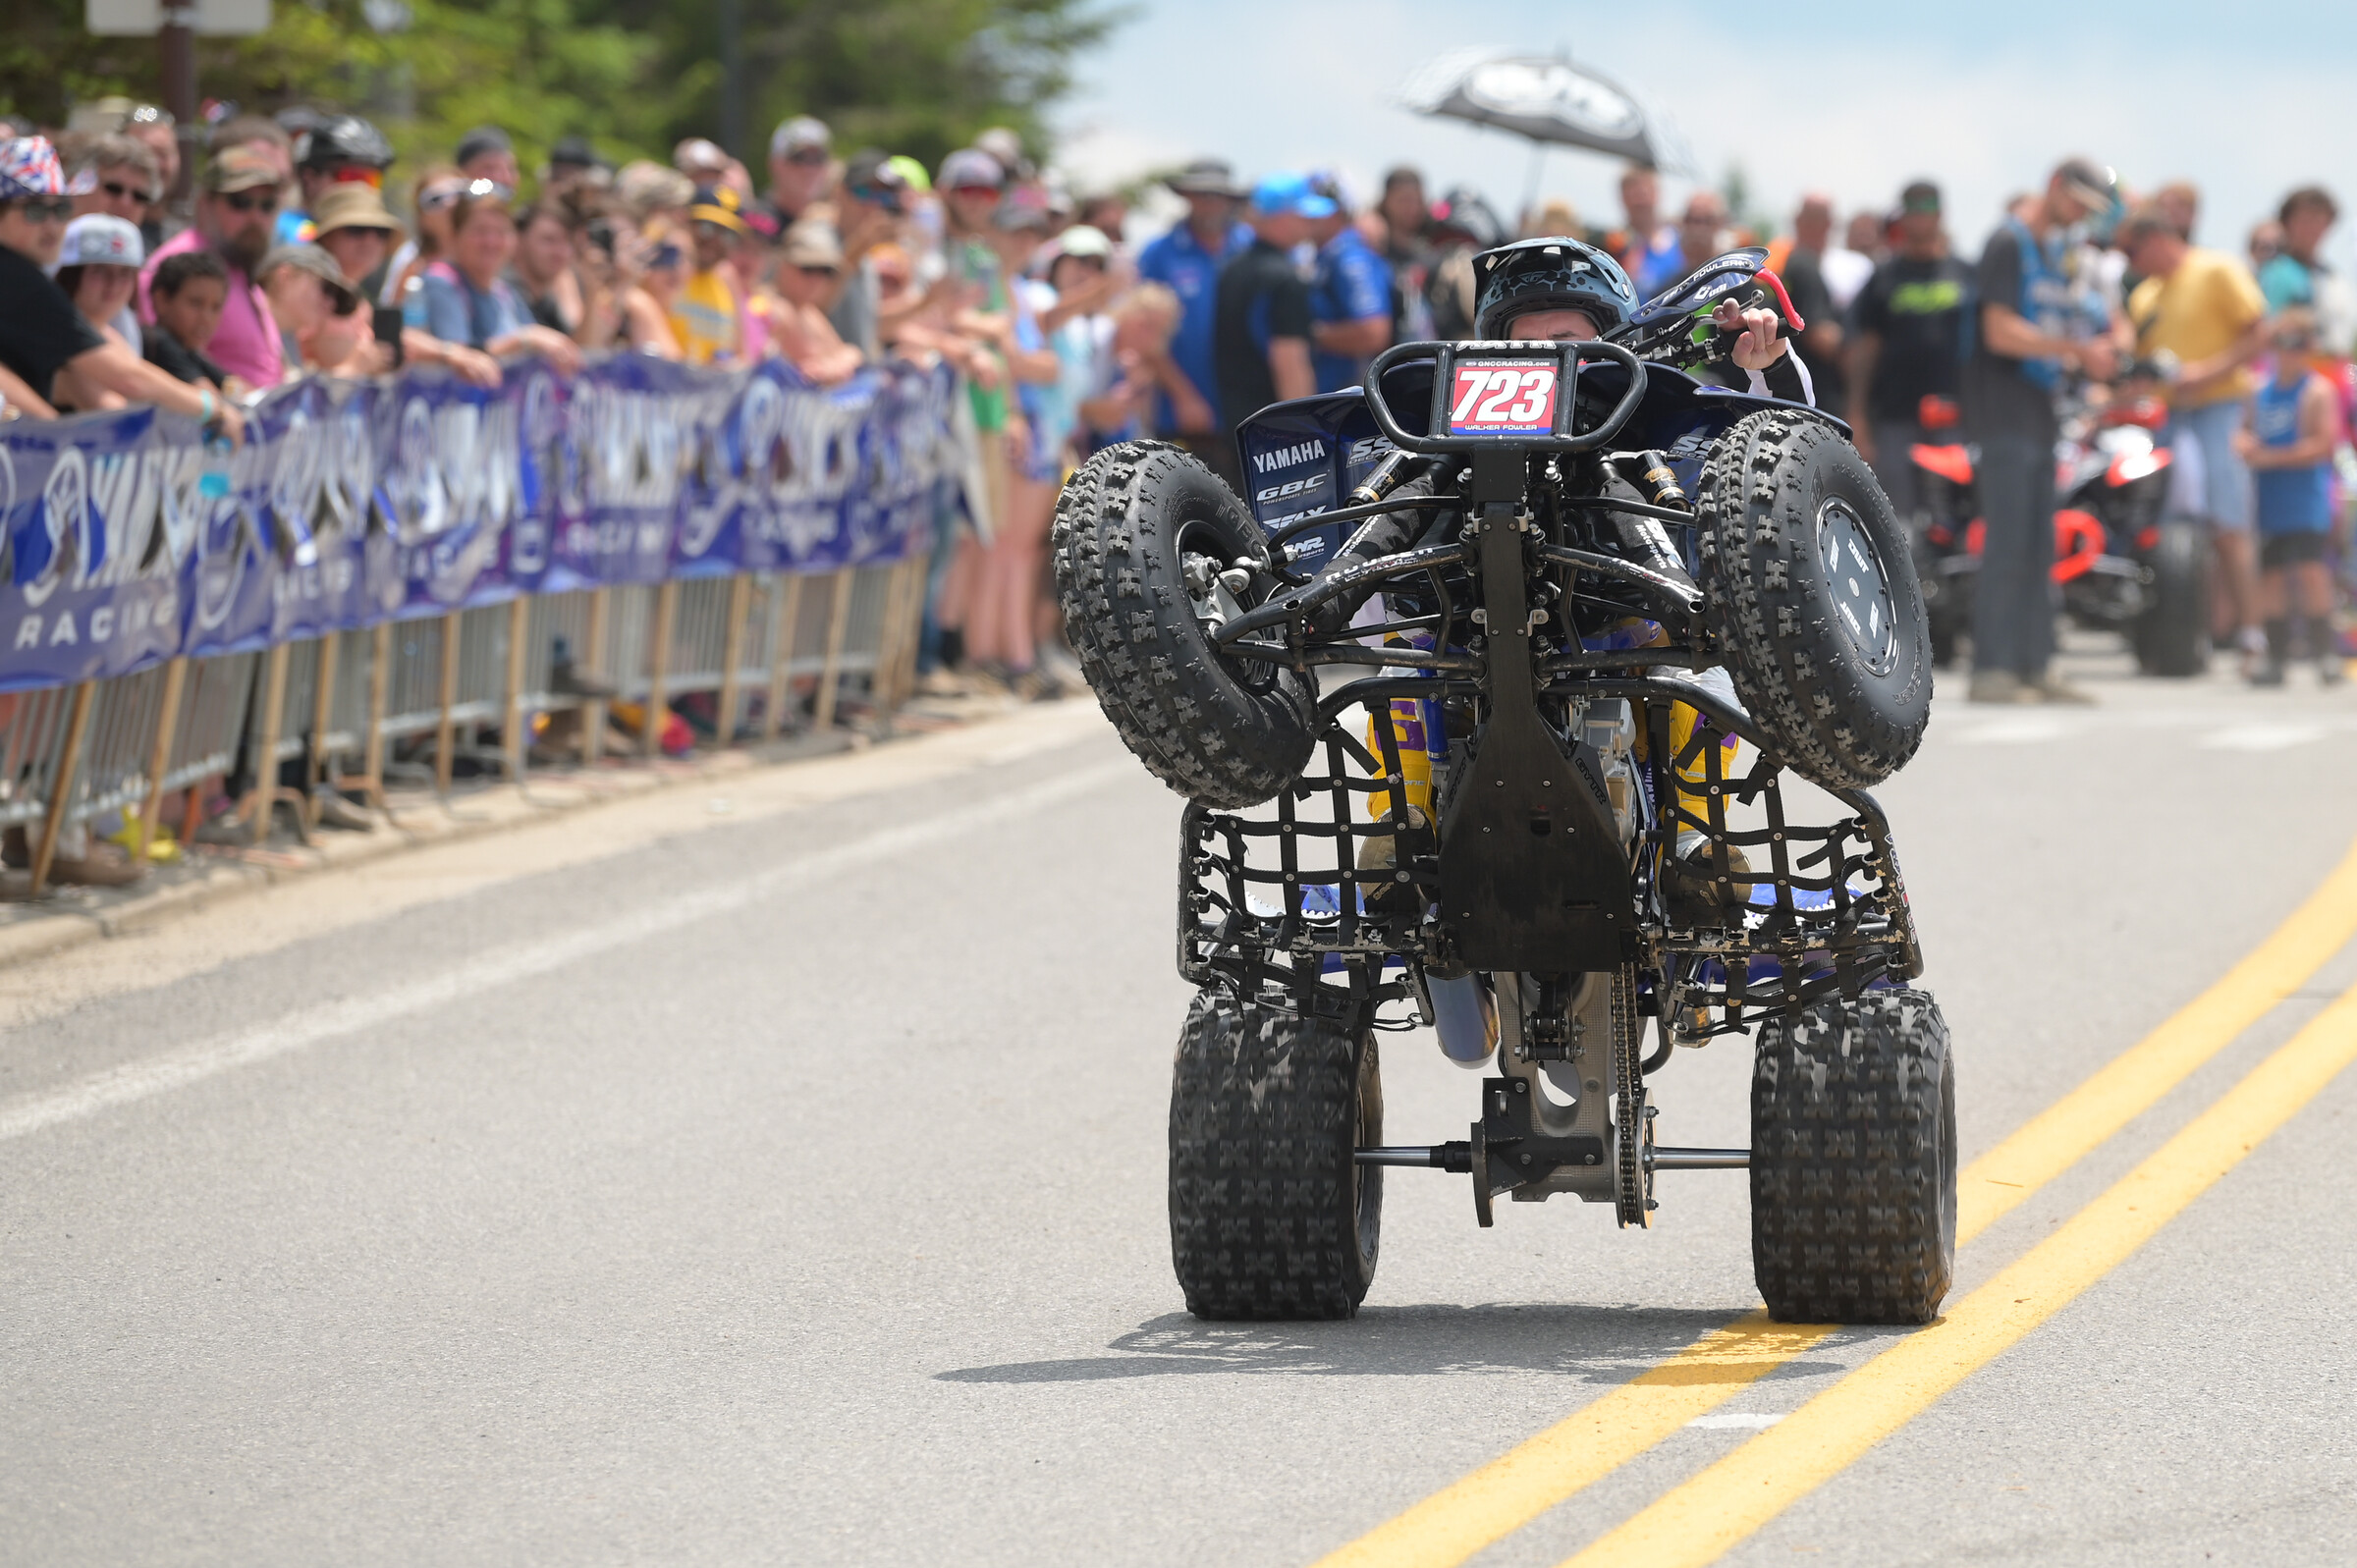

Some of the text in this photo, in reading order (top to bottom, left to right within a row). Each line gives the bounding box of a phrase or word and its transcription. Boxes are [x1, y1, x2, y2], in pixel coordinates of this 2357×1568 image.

[1693, 259, 1741, 281] FOWLER
[1452, 370, 1555, 422] 723
[1253, 439, 1326, 473] YAMAHA
[1256, 473, 1327, 502] GBC
[1263, 493, 1301, 506] POWERSPORTS
[1343, 514, 1382, 557] Motorspor
[1635, 524, 1668, 569] Motorsports
[1848, 538, 1870, 573] DWT
[1574, 757, 1607, 805] GYTR
